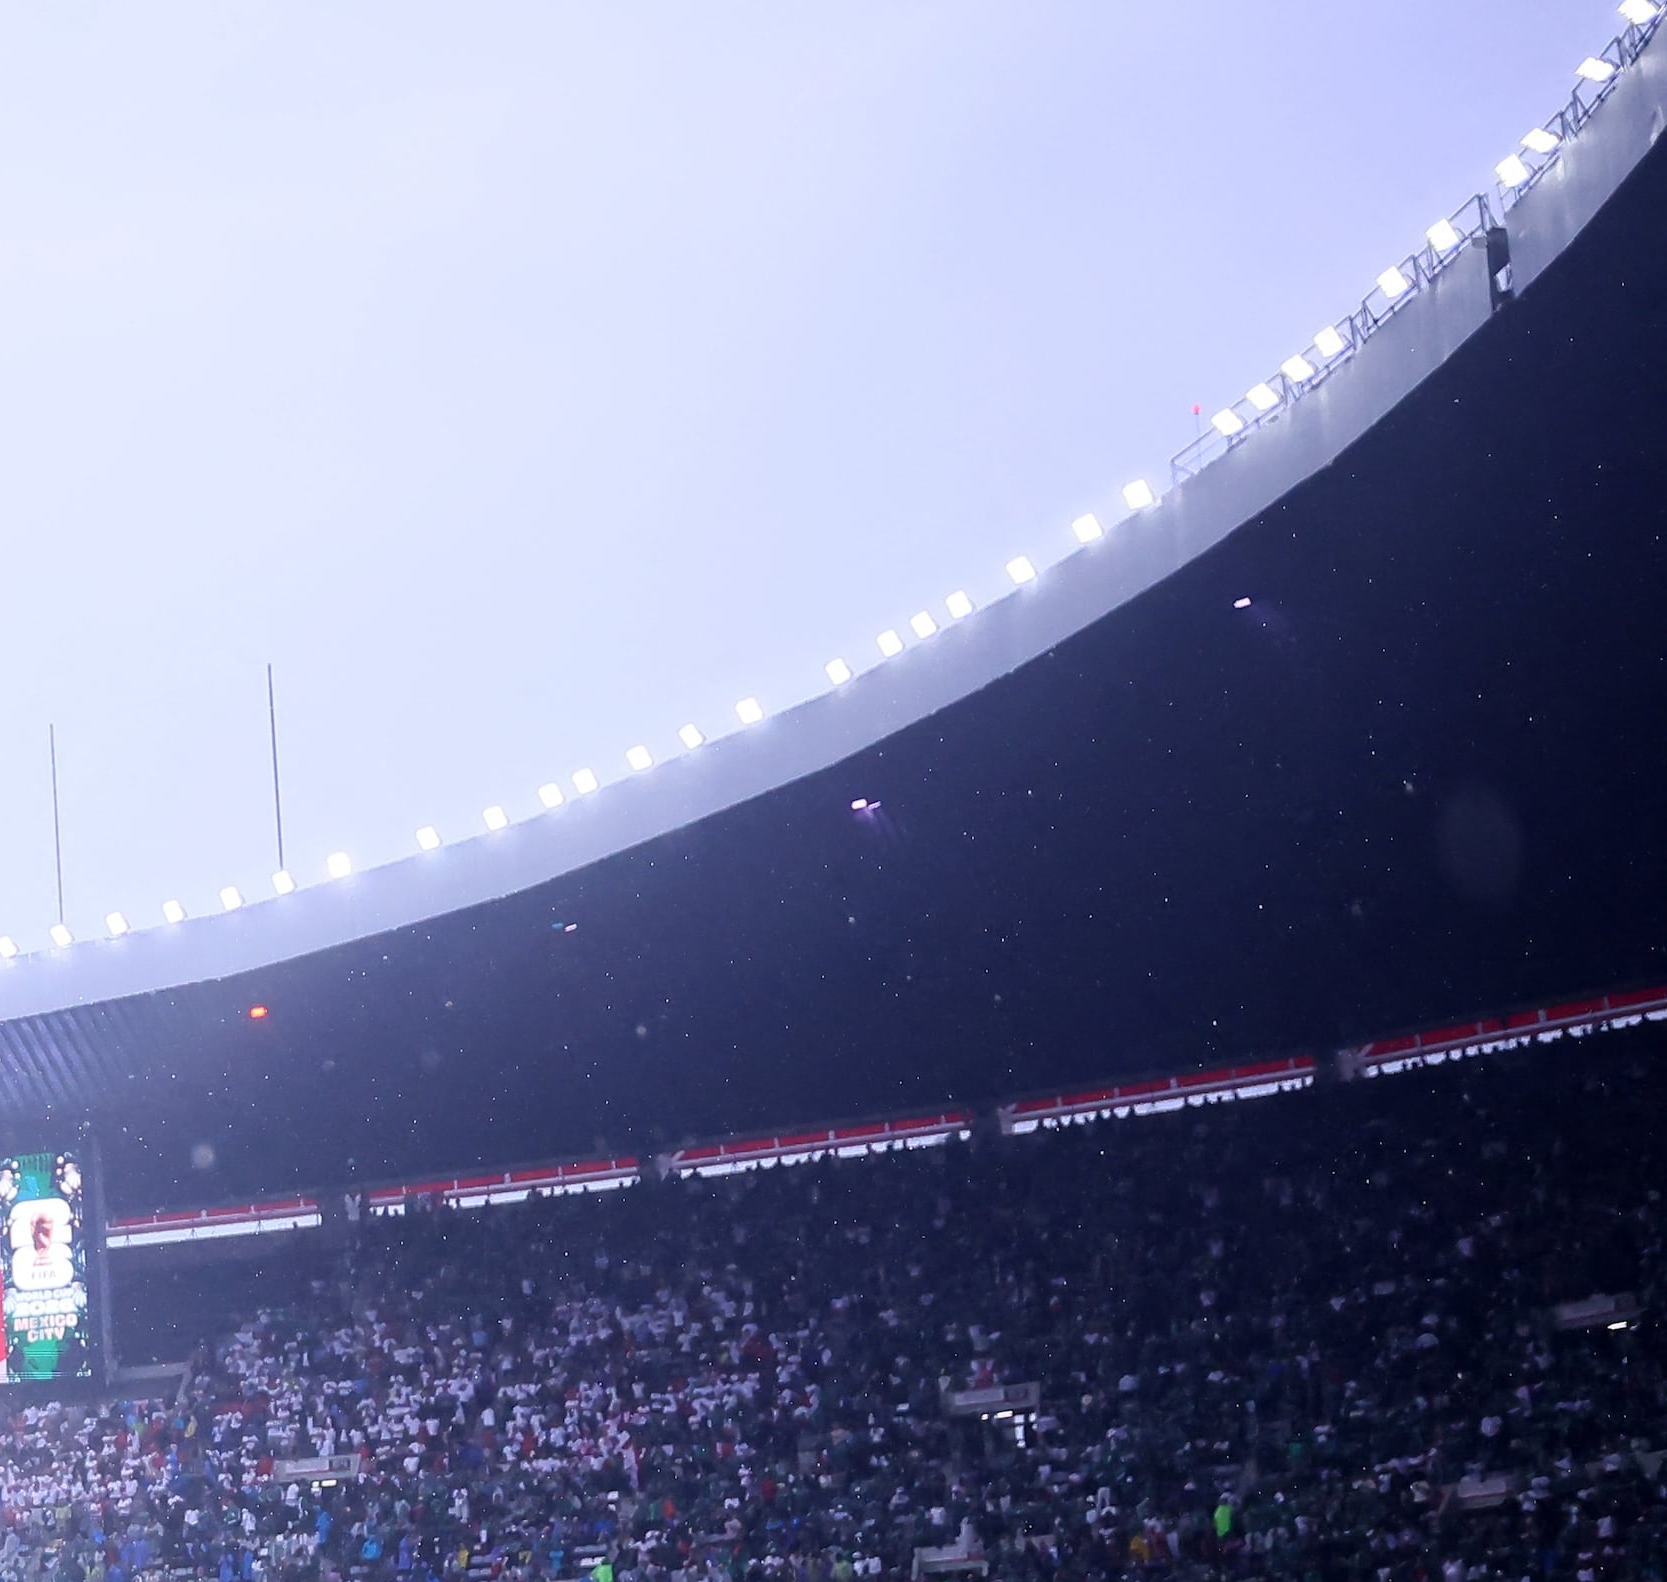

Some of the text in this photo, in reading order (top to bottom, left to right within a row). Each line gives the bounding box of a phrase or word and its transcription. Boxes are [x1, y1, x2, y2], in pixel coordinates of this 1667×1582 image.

[31, 1270, 57, 1280] FIFA
[14, 1313, 78, 1331] MEXICO
[27, 1328, 65, 1342] CITY
